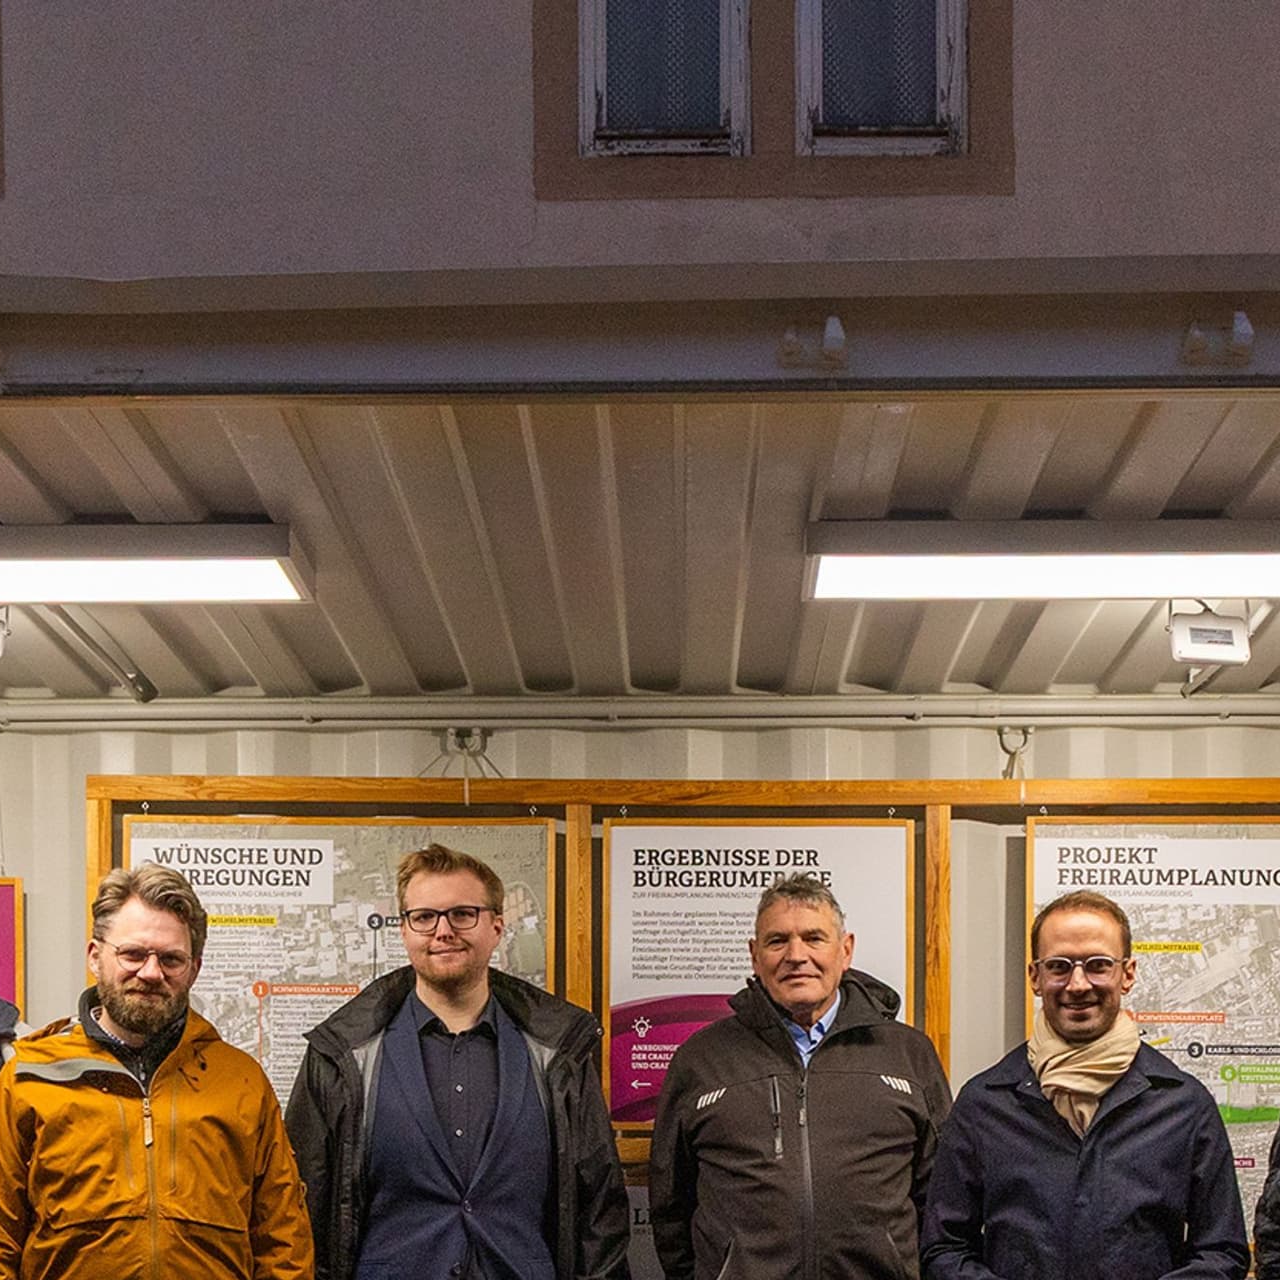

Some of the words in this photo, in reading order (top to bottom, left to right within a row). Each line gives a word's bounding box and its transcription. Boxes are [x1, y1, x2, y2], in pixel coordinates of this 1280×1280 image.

[153, 843, 267, 865] WÜNSCHE
[274, 848, 323, 865] UND
[632, 849, 770, 866] ERGEBNISSE
[775, 849, 819, 866] DER
[1057, 847, 1158, 864] PROJEKT
[184, 869, 311, 886] REGUNGEN
[371, 917, 379, 926] 3
[718, 910, 756, 918] Neugestalt
[1192, 1046, 1199, 1055] 3
